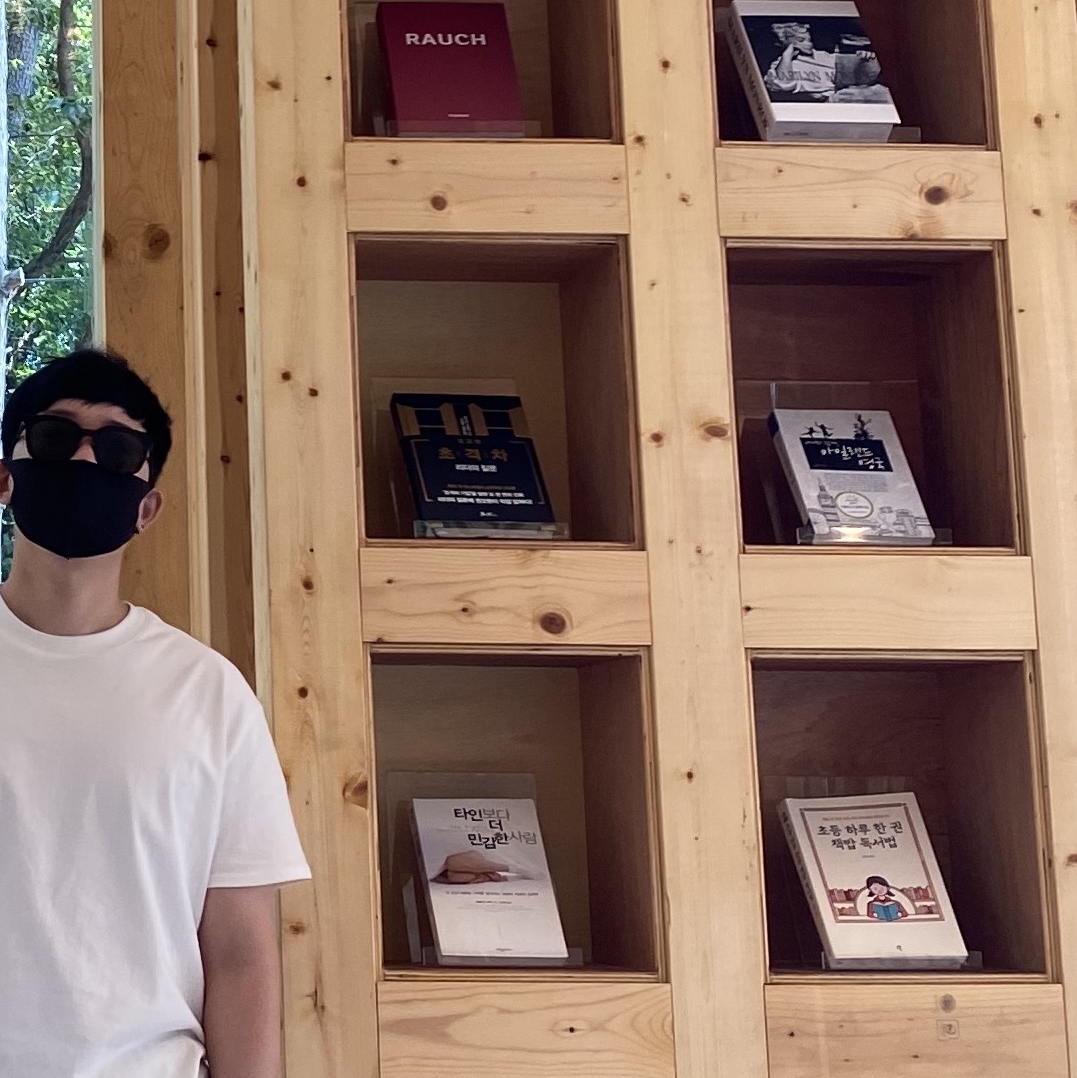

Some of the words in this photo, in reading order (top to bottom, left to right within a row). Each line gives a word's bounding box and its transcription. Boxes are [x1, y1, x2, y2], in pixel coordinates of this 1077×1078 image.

[405, 33, 487, 46] RAUCH
[488, 819, 504, 831] 더
[817, 824, 842, 837] 초등
[845, 823, 871, 836] 하루
[873, 822, 887, 835] 한
[889, 820, 904, 834] 권
[467, 831, 510, 849] 민감한
[509, 831, 538, 845] 사람
